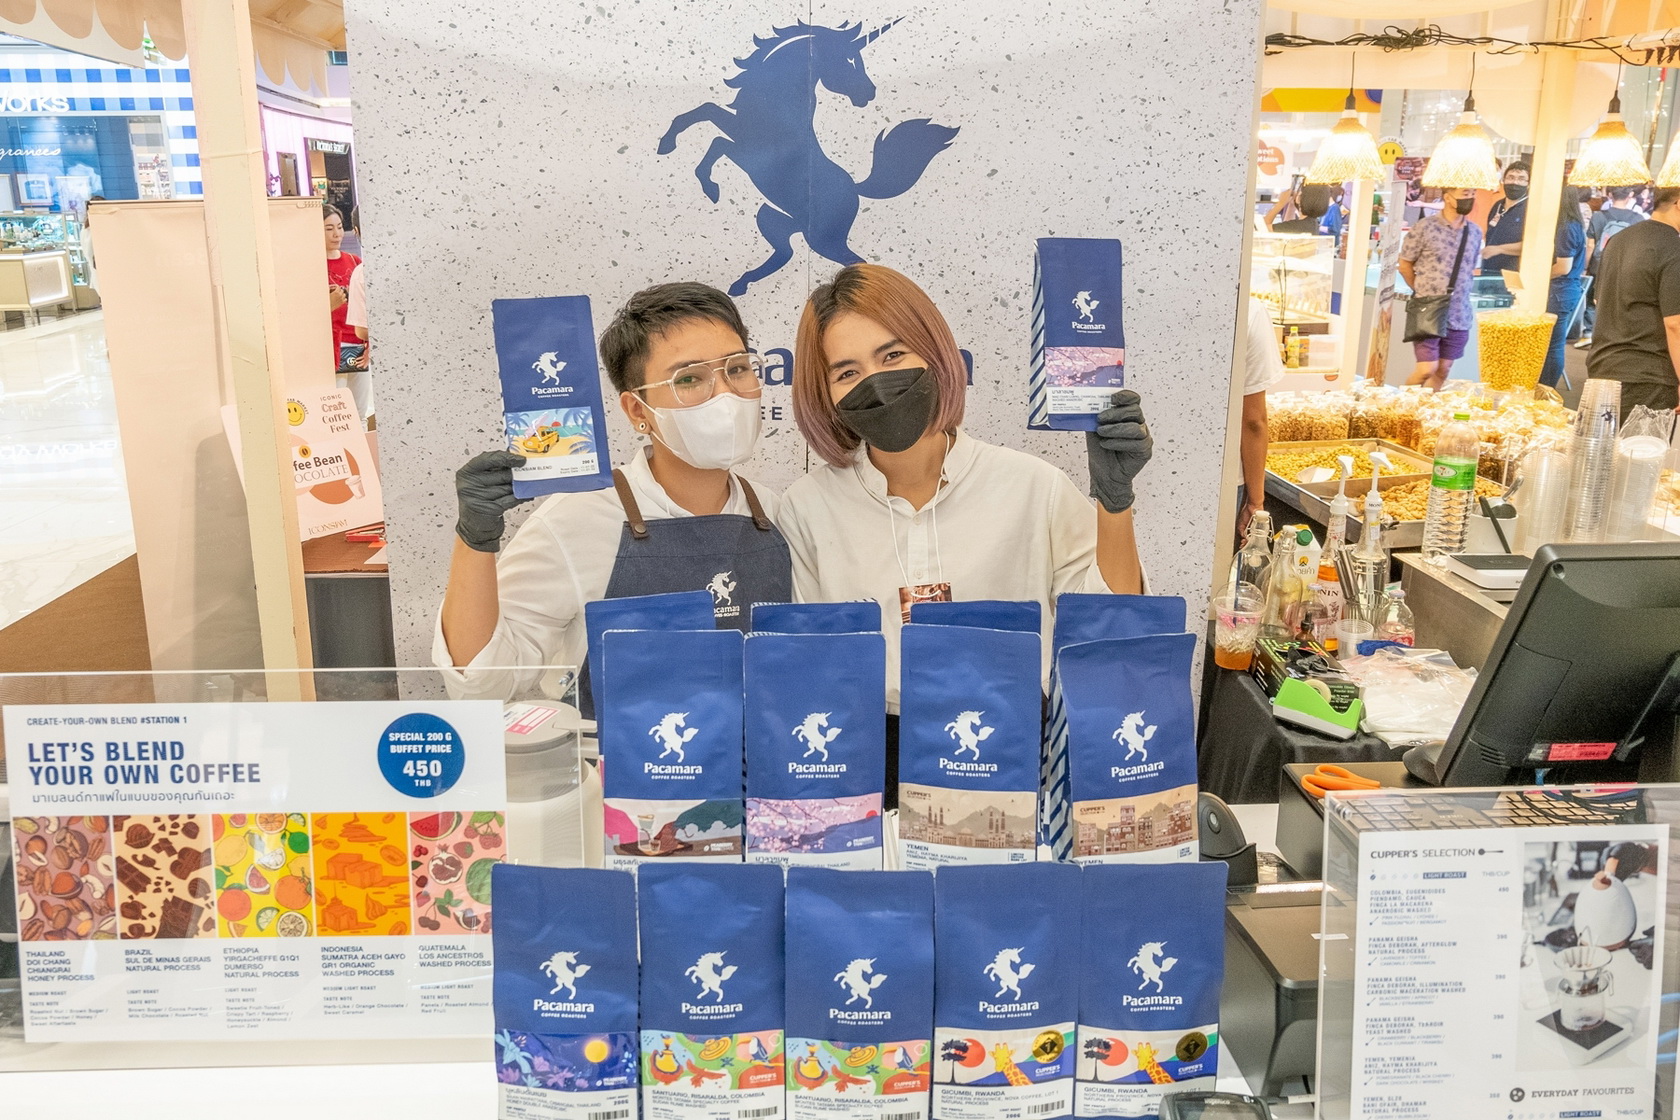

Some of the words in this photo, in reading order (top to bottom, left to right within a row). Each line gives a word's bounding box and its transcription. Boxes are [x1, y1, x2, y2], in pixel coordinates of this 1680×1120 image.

[1071, 322, 1106, 330] Pacamara
[531, 386, 574, 395] Pacamara
[321, 401, 347, 413] Craft
[322, 413, 352, 425] Coffee
[330, 423, 351, 434] Fest
[313, 454, 343, 469] Bean
[27, 716, 108, 726] CREATE-YOUR-OWN
[110, 716, 137, 725] BLEND
[140, 716, 180, 724] #STATION
[183, 716, 187, 724] 1
[389, 732, 425, 742] SPECIAL
[426, 732, 443, 742] 200
[445, 732, 452, 741] G
[28, 742, 95, 762] LET'S
[106, 741, 185, 762] BLEND
[390, 744, 423, 754] BUFFET
[425, 744, 452, 753] PRICE
[403, 760, 442, 777] 450
[644, 762, 702, 775] Pacamara
[788, 762, 846, 774] Pacamara
[939, 758, 998, 772] Pacamara
[1110, 760, 1164, 778] Pacamara
[29, 765, 93, 786] YOUR
[104, 764, 159, 784] OWN
[170, 763, 261, 784] COFFEE
[414, 779, 432, 787] THB
[906, 843, 929, 851] YEMEN
[1370, 850, 1418, 859] CUPPER'S
[1422, 848, 1476, 858] SELECTION
[26, 950, 66, 958] THAILAND
[419, 952, 434, 960] LOS
[42, 958, 71, 966] CHANG
[155, 956, 180, 964] MINAS
[164, 964, 201, 972] PROCESS
[58, 974, 95, 982] PROCESS
[1122, 994, 1183, 1006] Pacamara
[533, 999, 594, 1013] Pacamara
[681, 1002, 743, 1015] Pacamara
[978, 1000, 1040, 1013] Pacamara
[829, 1008, 892, 1020] Pacamara
[652, 1089, 689, 1098] SANTUARIO,
[730, 1092, 765, 1100] COLOMBIA
[941, 1089, 973, 1097] GICUMBI,
[1531, 1090, 1579, 1098] EVERYDAY
[1582, 1087, 1634, 1096] FAVOURITES
[795, 1094, 832, 1103] SANTUARIO,
